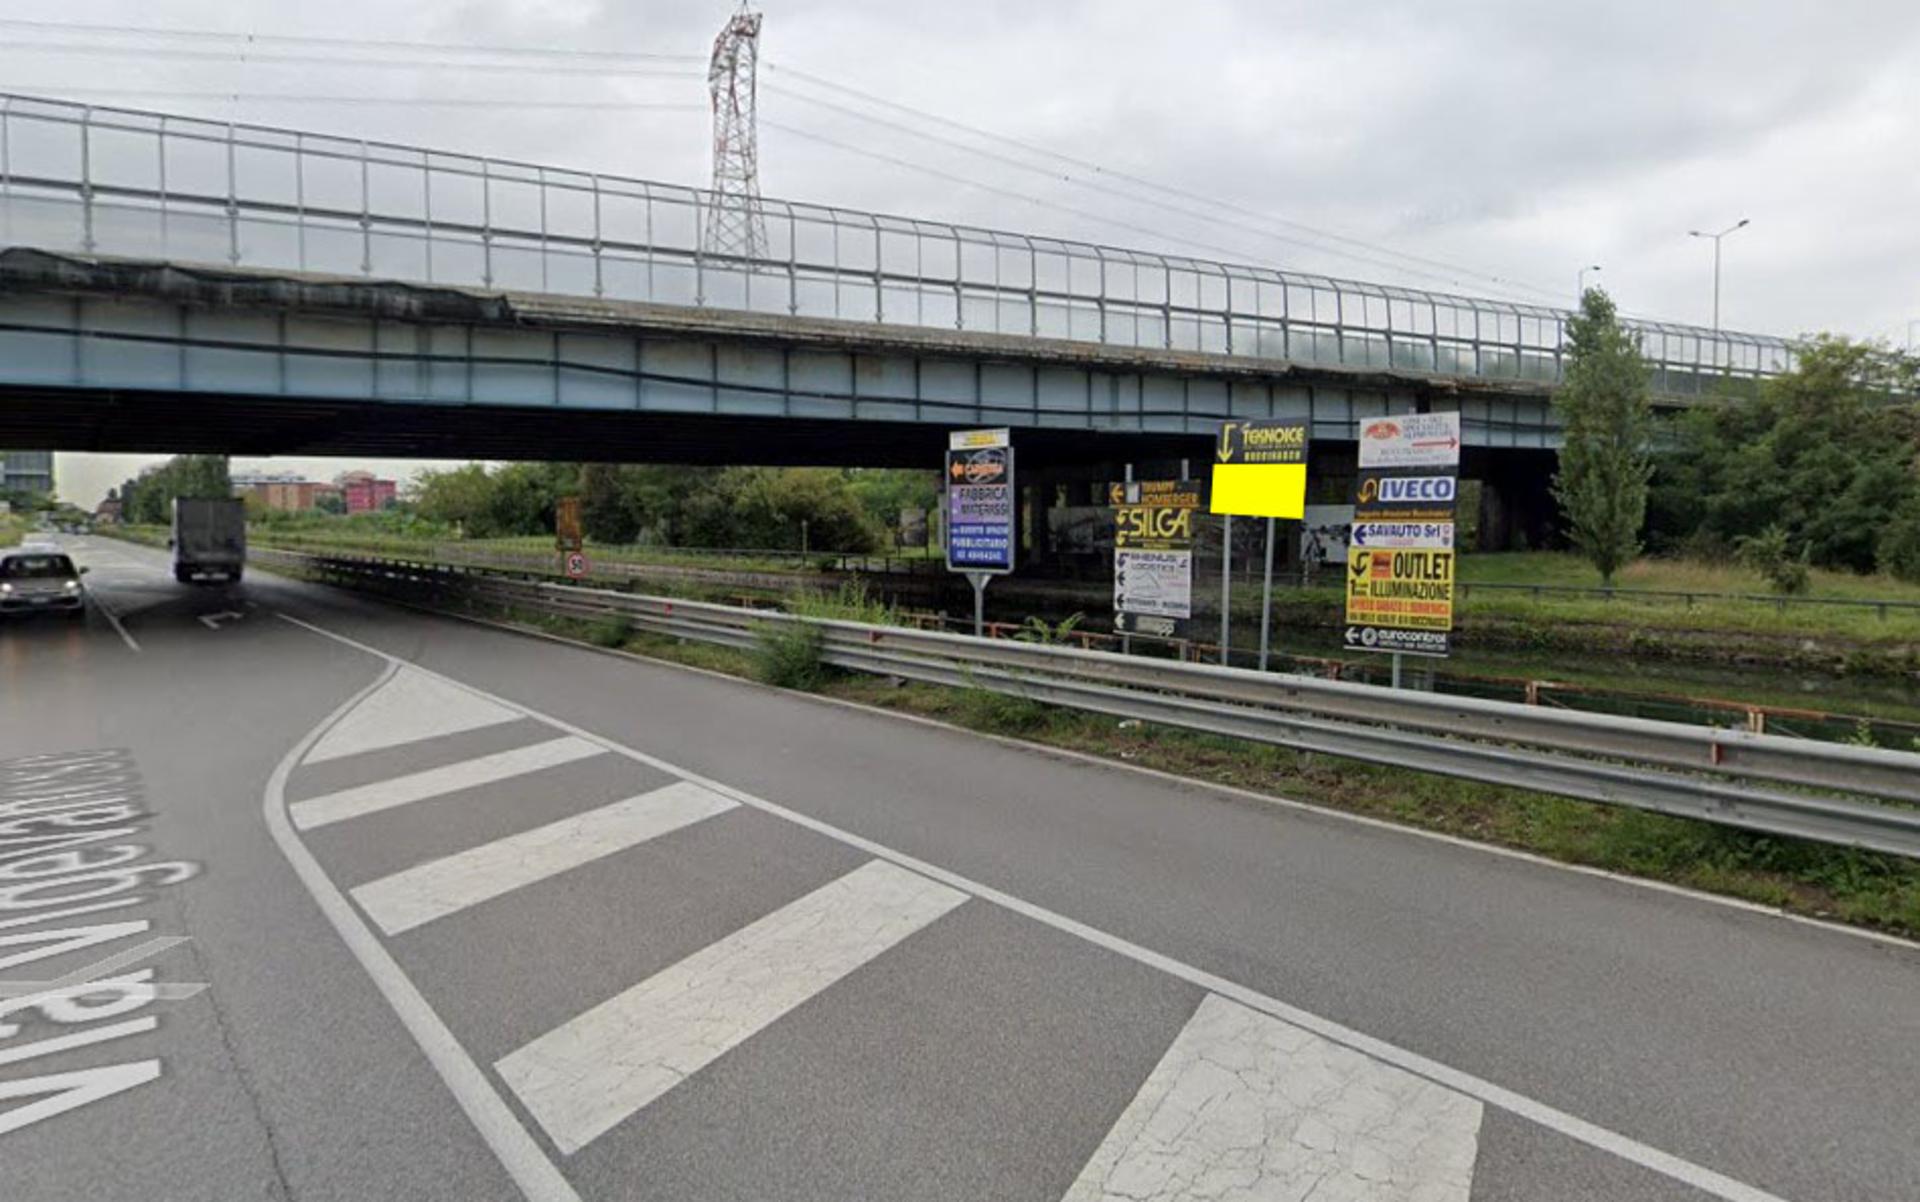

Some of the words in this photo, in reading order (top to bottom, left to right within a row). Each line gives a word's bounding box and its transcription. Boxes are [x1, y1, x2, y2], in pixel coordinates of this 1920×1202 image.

[1242, 425, 1304, 447] TEKNOICE
[960, 486, 1008, 500] FABBRICA
[1381, 479, 1452, 499] IVECO
[1129, 508, 1191, 538] SILGA
[1368, 524, 1421, 537] SAVAUTO
[1424, 525, 1440, 538] Srl
[952, 537, 1008, 549] PUBBLICITARIO
[1394, 552, 1452, 580] OUTLET
[1370, 580, 1450, 601] ILLUMINAZIONE
[1379, 629, 1447, 643] eurocontrol
